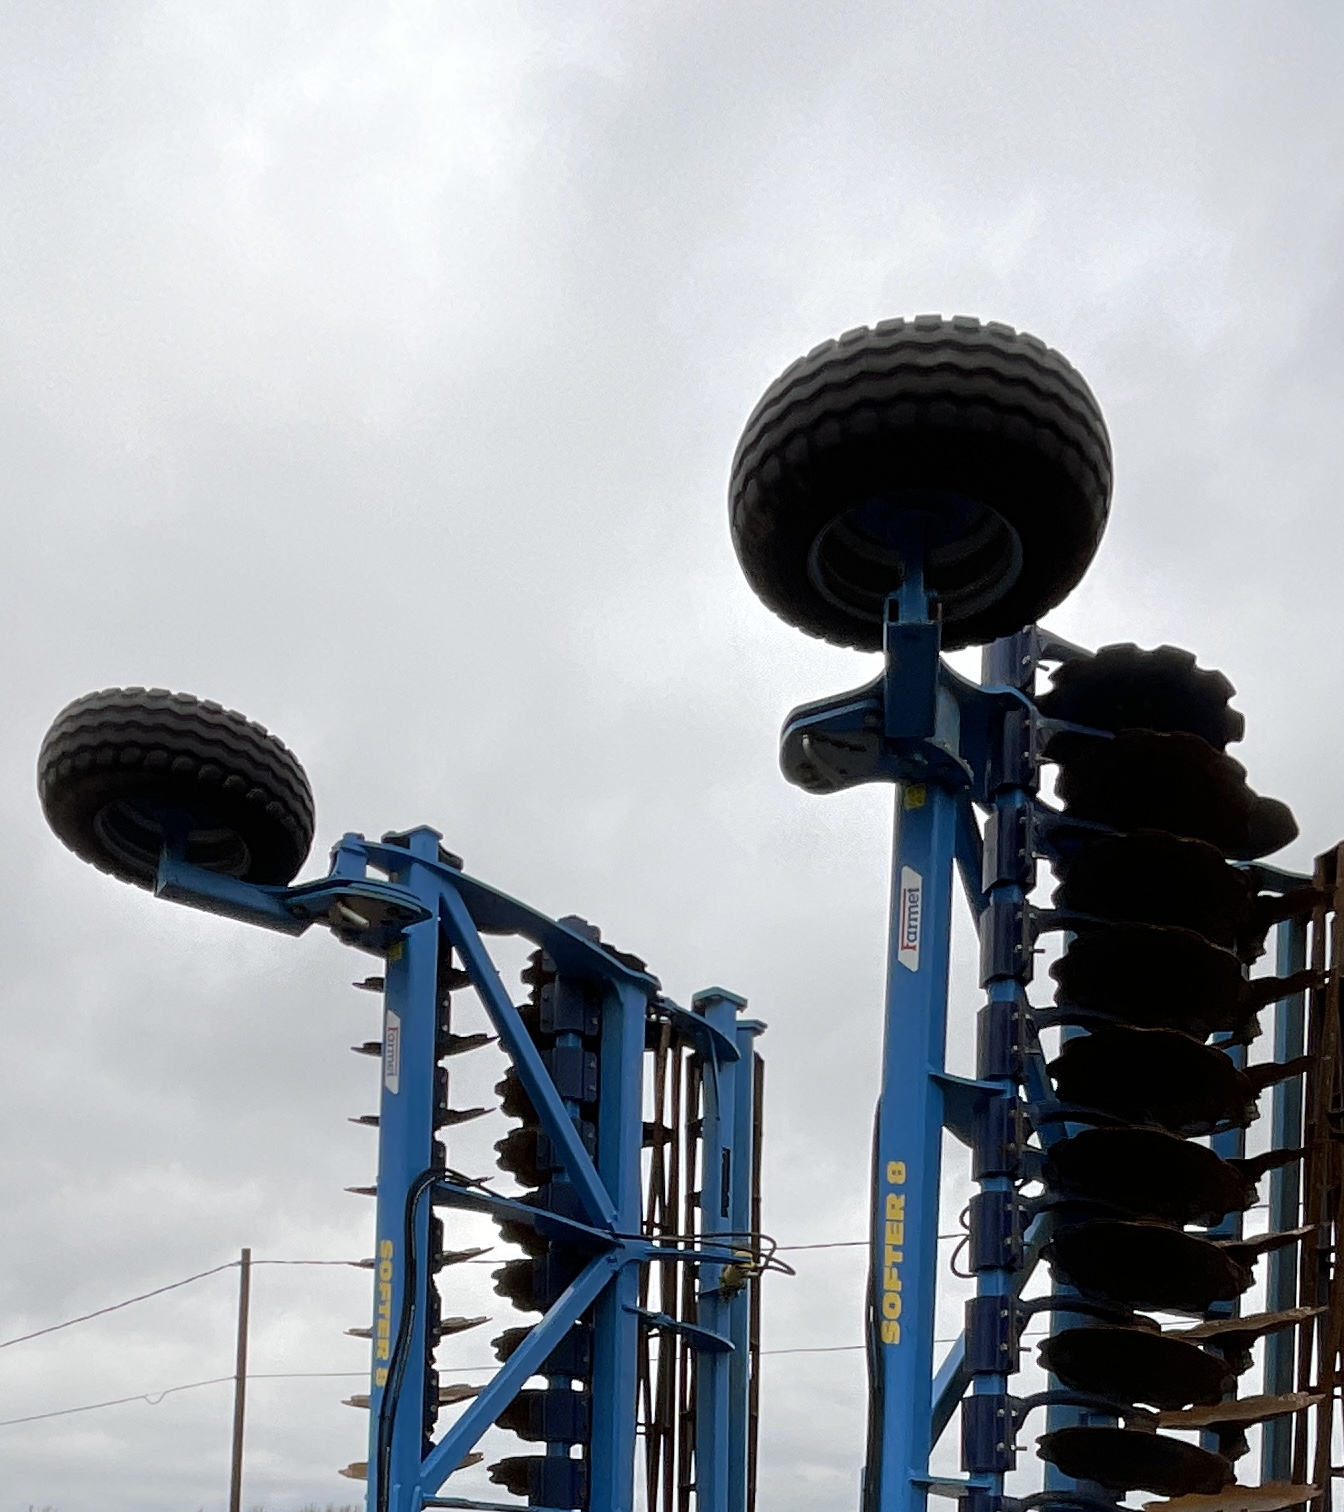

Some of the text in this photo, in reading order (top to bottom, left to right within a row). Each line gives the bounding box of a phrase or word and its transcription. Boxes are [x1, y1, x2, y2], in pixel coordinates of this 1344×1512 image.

[901, 888, 920, 950] Farmet
[376, 1239, 393, 1361] SOFTER
[881, 1160, 907, 1345] SOFTER 8
